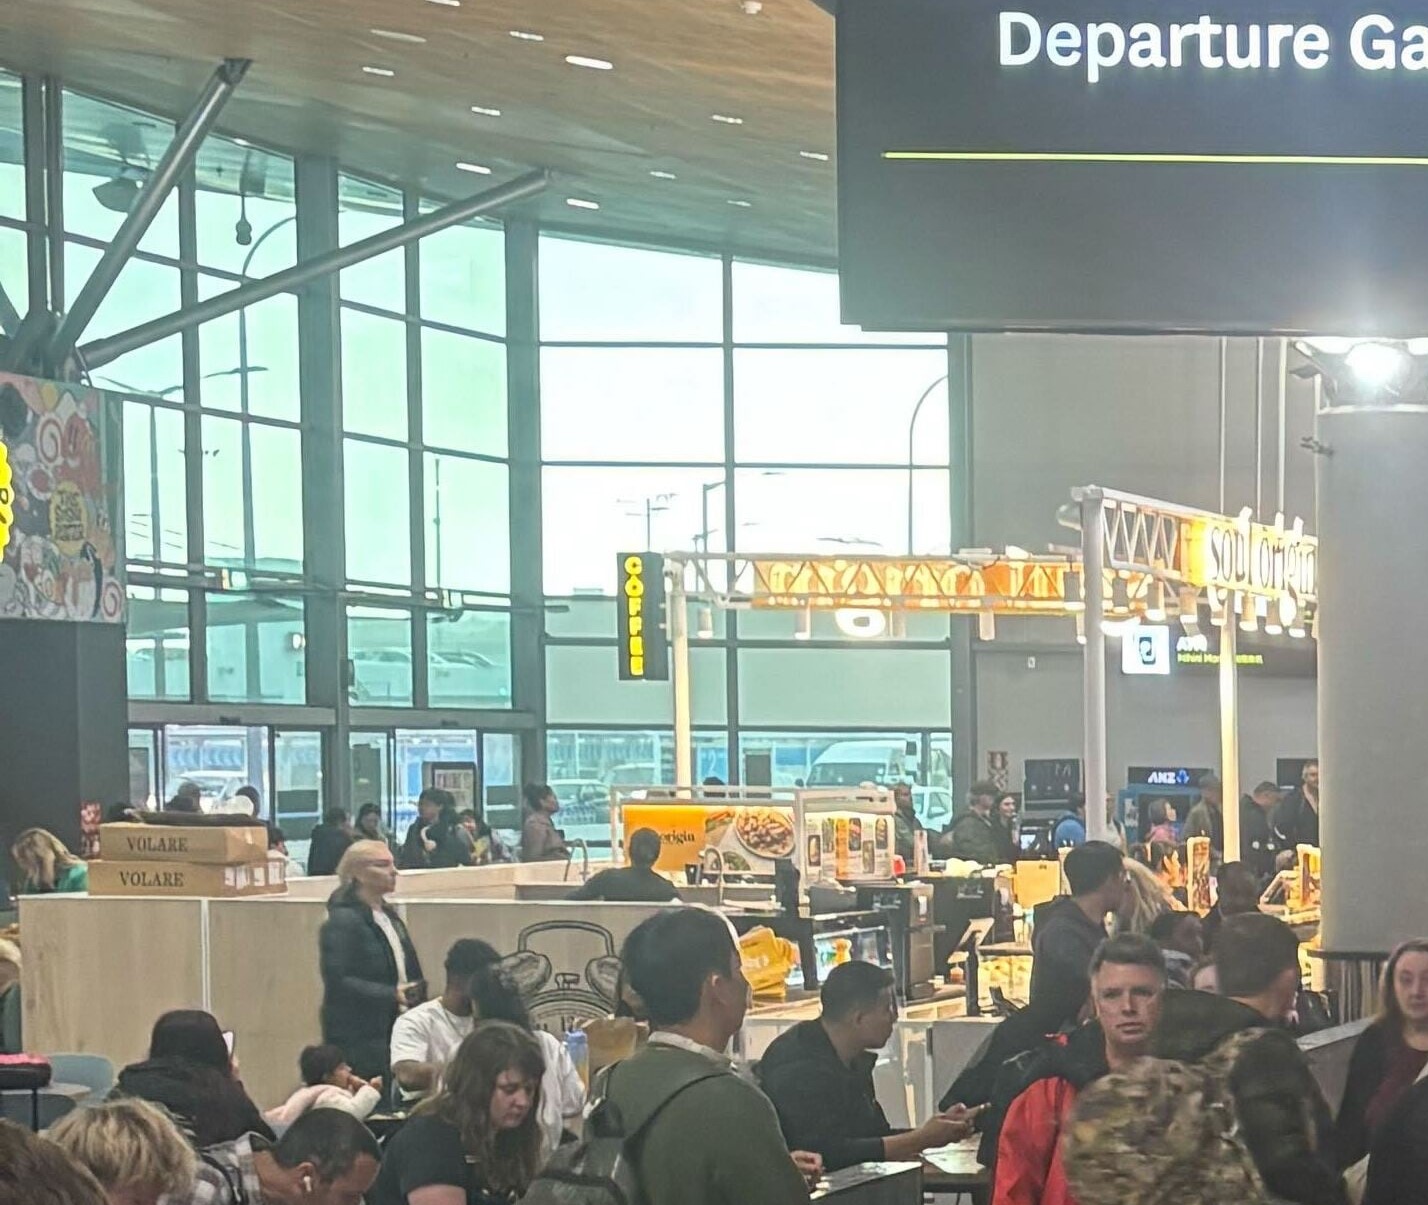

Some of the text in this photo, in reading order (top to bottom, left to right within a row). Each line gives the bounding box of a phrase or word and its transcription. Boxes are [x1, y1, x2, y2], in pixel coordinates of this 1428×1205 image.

[1000, 12, 1330, 83] Departure
[623, 555, 645, 677] COFFEE
[1147, 770, 1176, 785] ANZ
[126, 836, 189, 853] VOLARE
[119, 870, 185, 887] VOLARE
